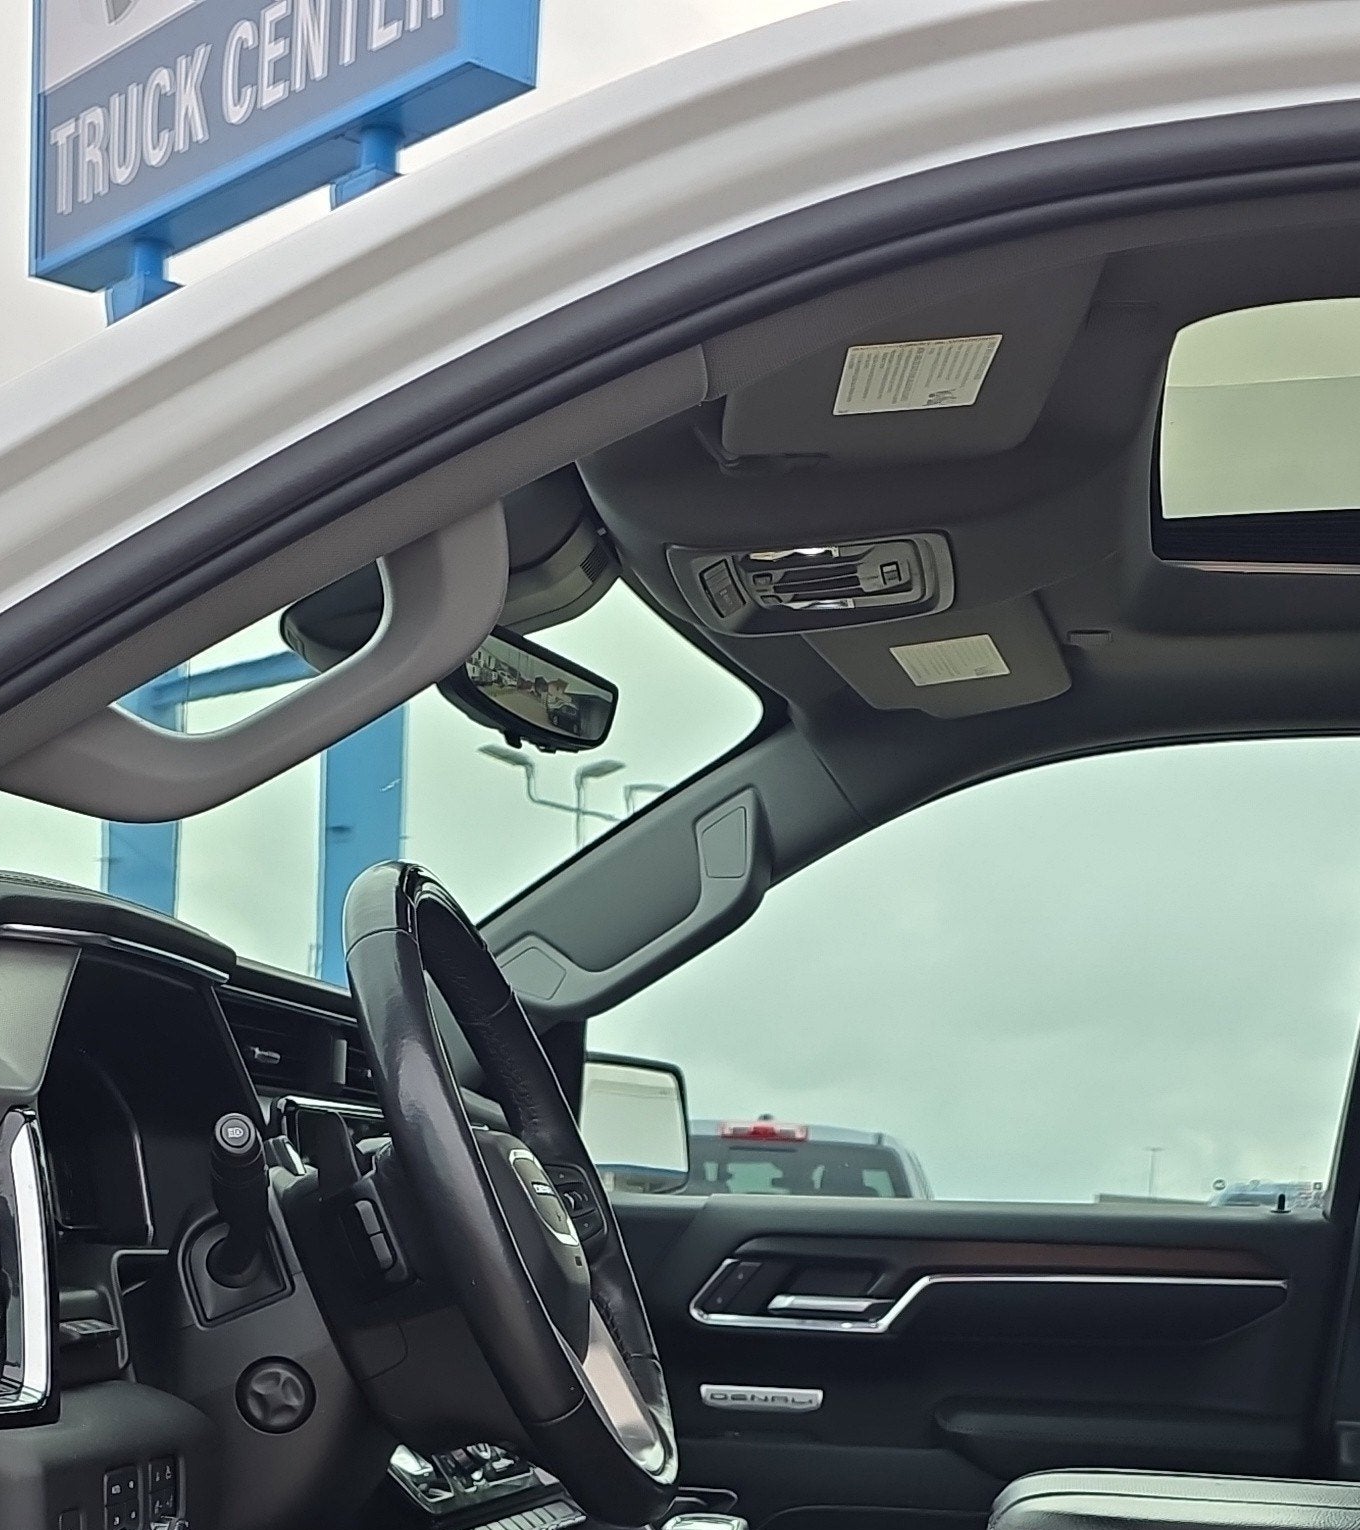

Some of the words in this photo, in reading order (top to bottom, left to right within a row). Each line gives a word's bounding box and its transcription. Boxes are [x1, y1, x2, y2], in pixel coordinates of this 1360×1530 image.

[50, 42, 211, 217] TRUCK
[222, 0, 445, 125] CENT
[710, 1392, 813, 1404] DENALI
